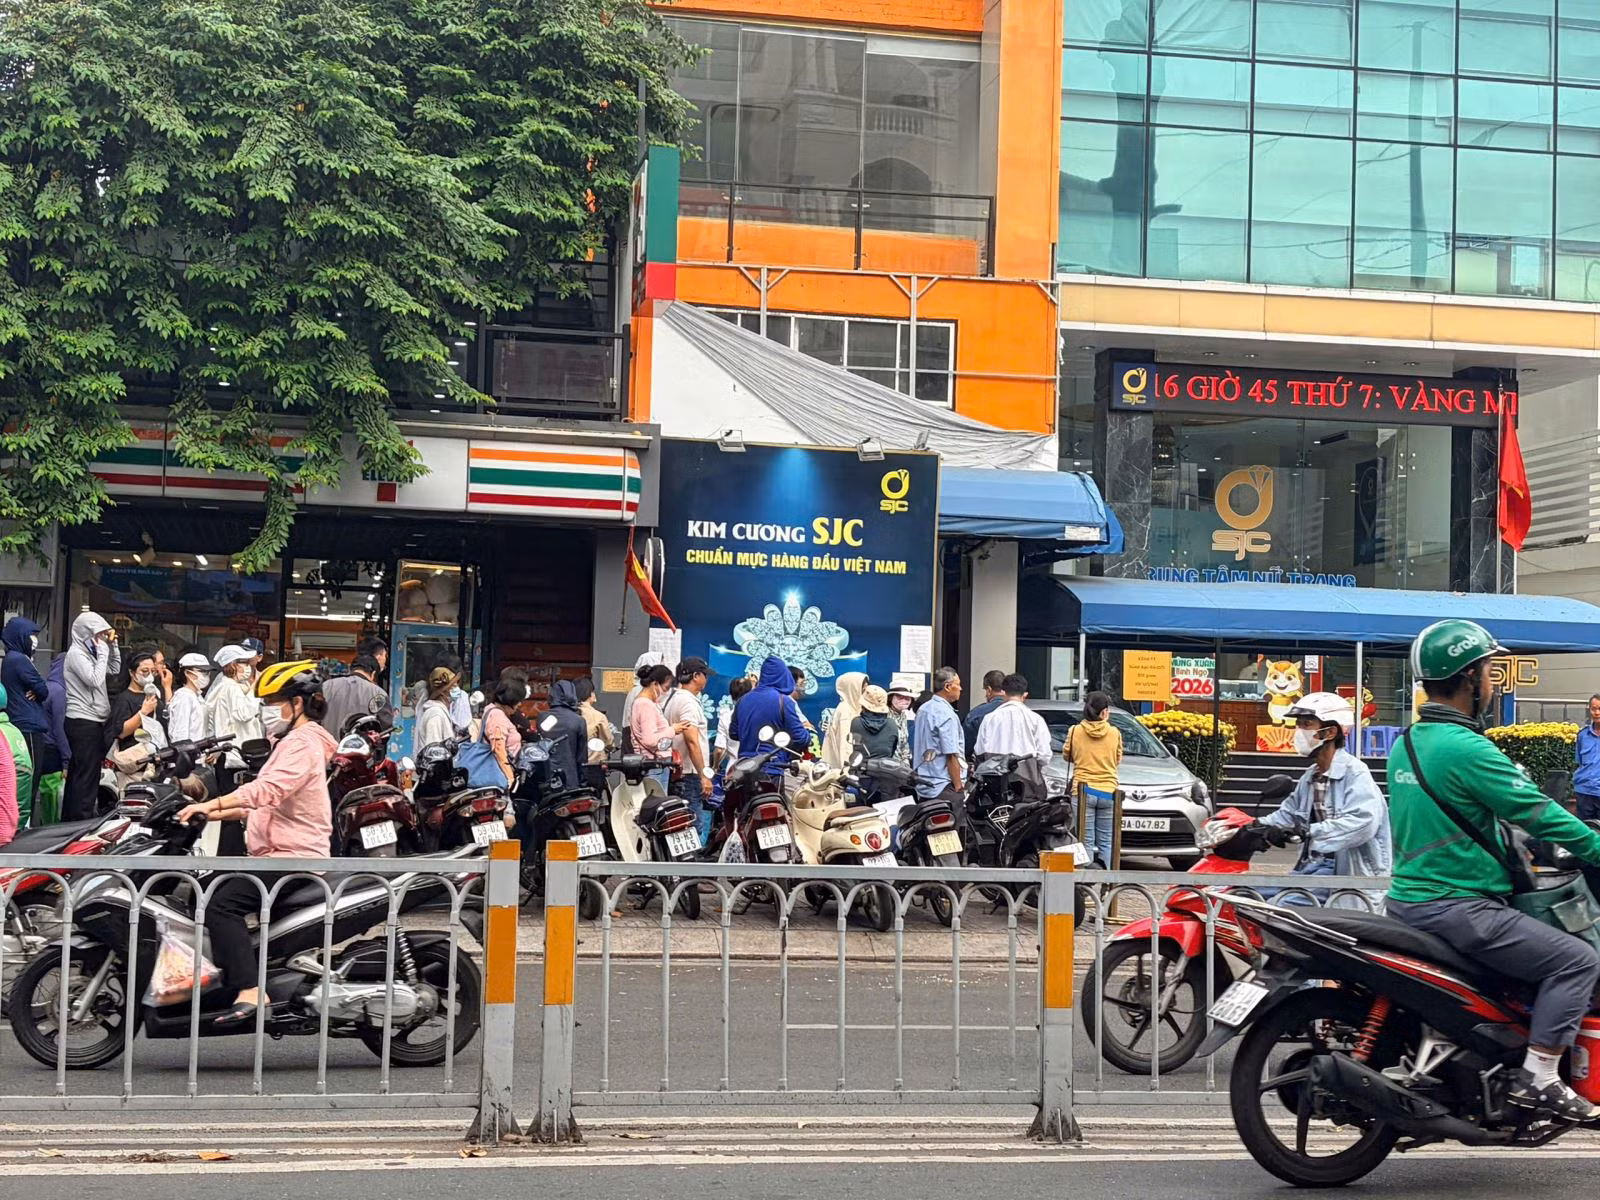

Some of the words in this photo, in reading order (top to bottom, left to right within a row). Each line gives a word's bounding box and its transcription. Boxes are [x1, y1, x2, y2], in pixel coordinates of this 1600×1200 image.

[1187, 370, 1242, 401] GIỜ
[1248, 379, 1278, 404] 45
[1287, 376, 1353, 406] THỨ
[1359, 384, 1381, 408] 7:
[1389, 380, 1476, 413] VÀNG
[687, 519, 727, 539] KIM
[732, 522, 806, 543] CƯƠNG
[812, 516, 864, 547] SJC
[1211, 529, 1271, 561] SJC
[686, 545, 733, 565] CHUẨN
[736, 551, 768, 569] MỰC
[771, 551, 809, 569] HÀNG
[843, 556, 872, 575] VIỆT
[874, 559, 907, 575] NAM
[1148, 566, 1199, 582] RUNG
[1202, 564, 1249, 583] TÂM
[1253, 565, 1284, 583] NỮ
[1286, 572, 1357, 588] TRANG
[1447, 634, 1480, 657] Grab
[1171, 678, 1212, 695] 2026
[1394, 769, 1419, 785] Gra
